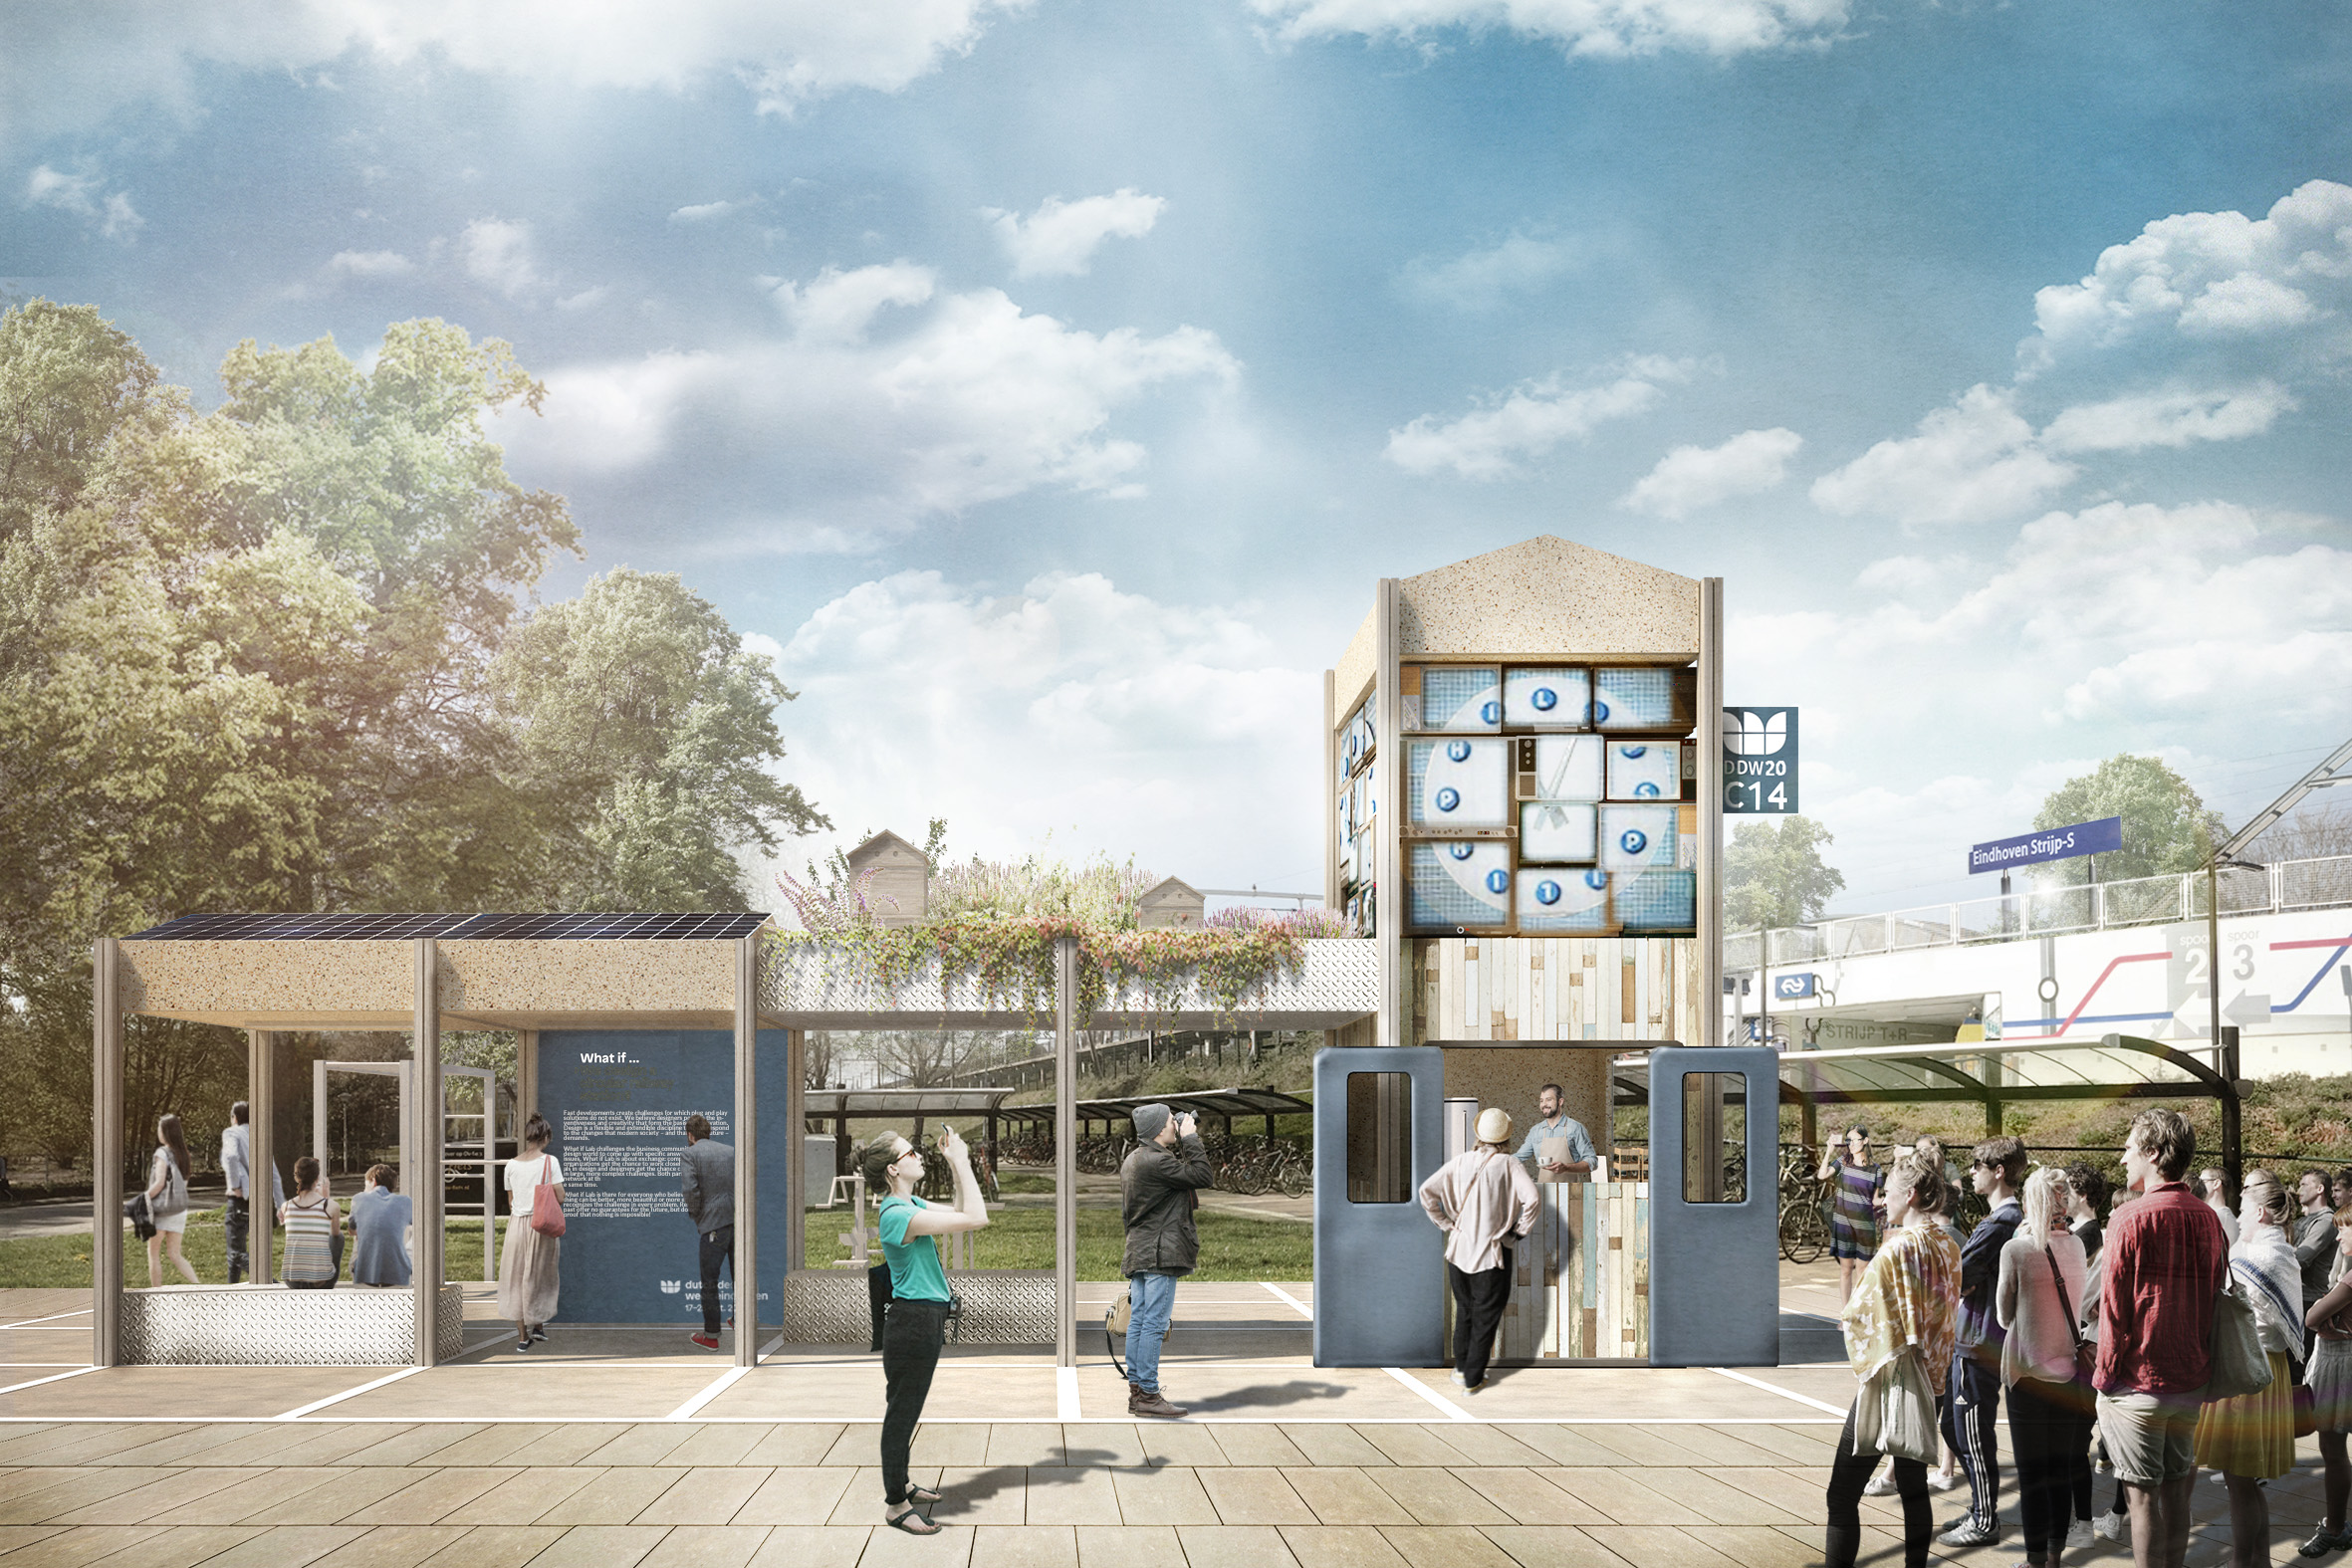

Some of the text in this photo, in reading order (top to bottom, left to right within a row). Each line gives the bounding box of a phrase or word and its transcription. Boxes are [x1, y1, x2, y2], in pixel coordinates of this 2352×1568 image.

[1724, 760, 1787, 777] DDW20
[1725, 781, 1788, 810] C14
[1973, 832, 2075, 866] Eindhoven Strijp-S
[2179, 934, 2209, 948] spoo
[2228, 929, 2260, 942] spoor
[2185, 948, 2209, 985] 2
[2233, 944, 2255, 981] 3
[1825, 1024, 1875, 1040] STRIJP
[580, 1052, 614, 1063] What
[617, 1051, 627, 1063] if
